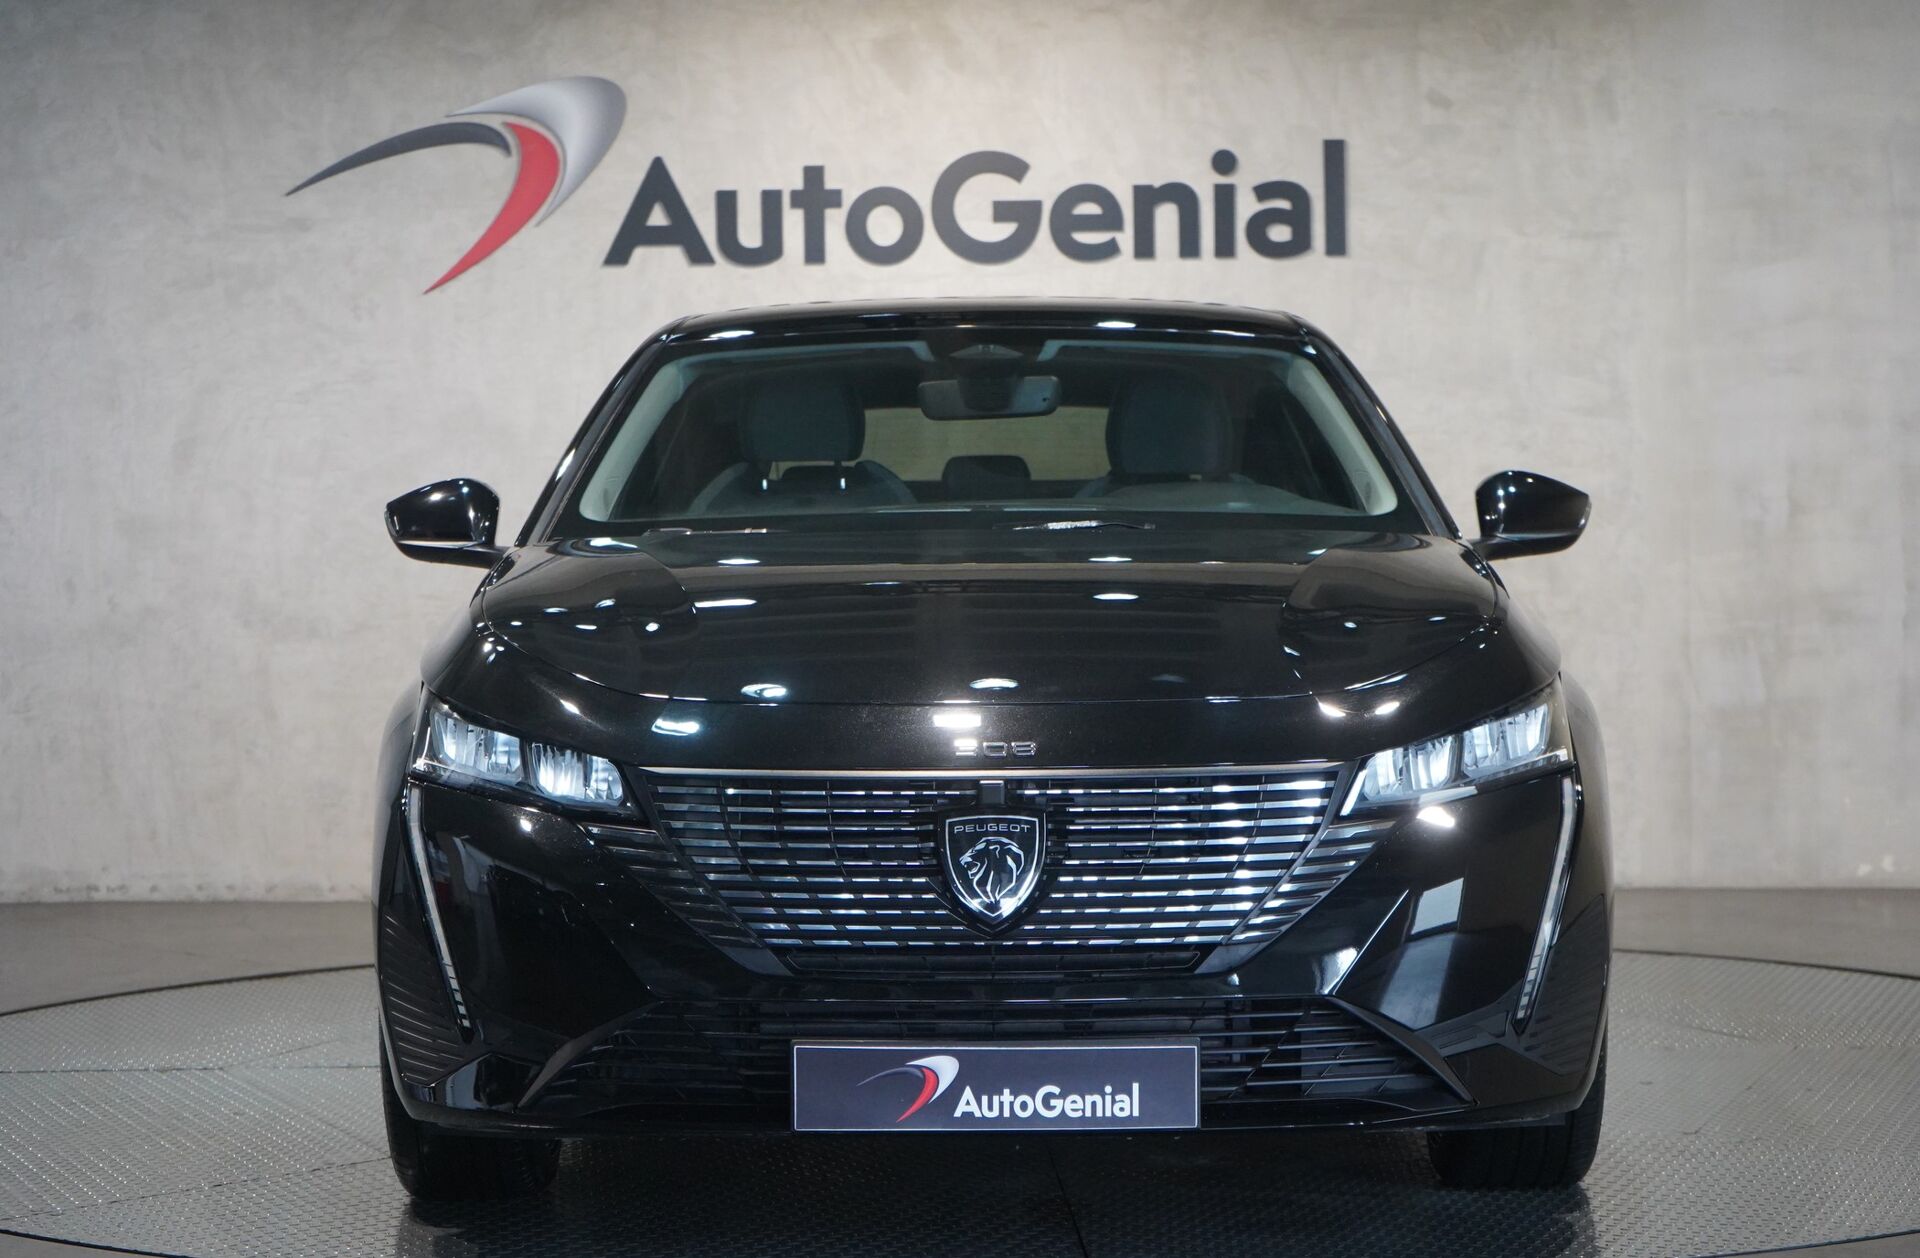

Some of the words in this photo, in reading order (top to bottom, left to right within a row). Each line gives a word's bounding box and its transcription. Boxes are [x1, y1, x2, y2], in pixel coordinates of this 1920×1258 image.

[602, 139, 1347, 266] AutoGenial
[954, 823, 1031, 834] PEUGEOT
[953, 1082, 1139, 1118] AutoGenial
